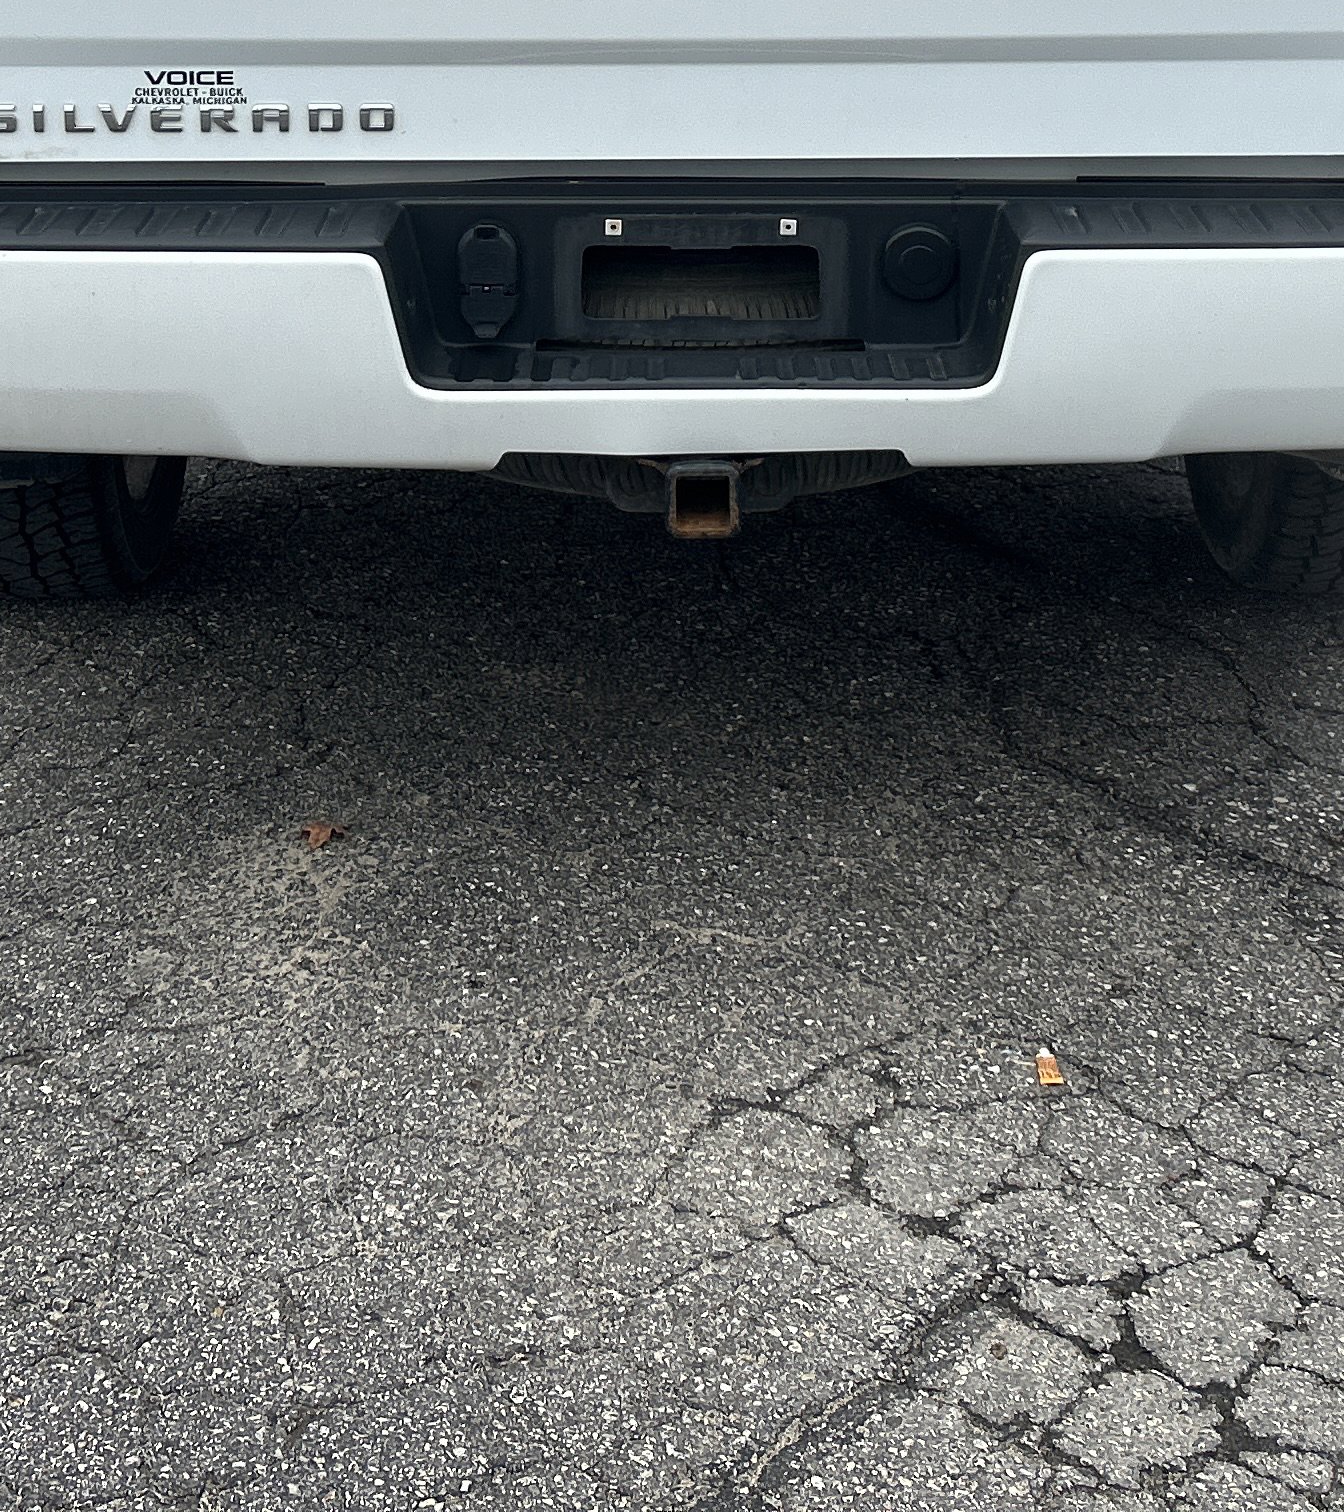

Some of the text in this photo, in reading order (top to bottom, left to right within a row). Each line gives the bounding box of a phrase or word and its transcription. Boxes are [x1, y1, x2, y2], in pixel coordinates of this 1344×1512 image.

[144, 71, 234, 85] VOICE
[135, 87, 199, 96] CHEVROLET
[210, 87, 244, 96] BUICK
[193, 96, 248, 105] MICHIGAN
